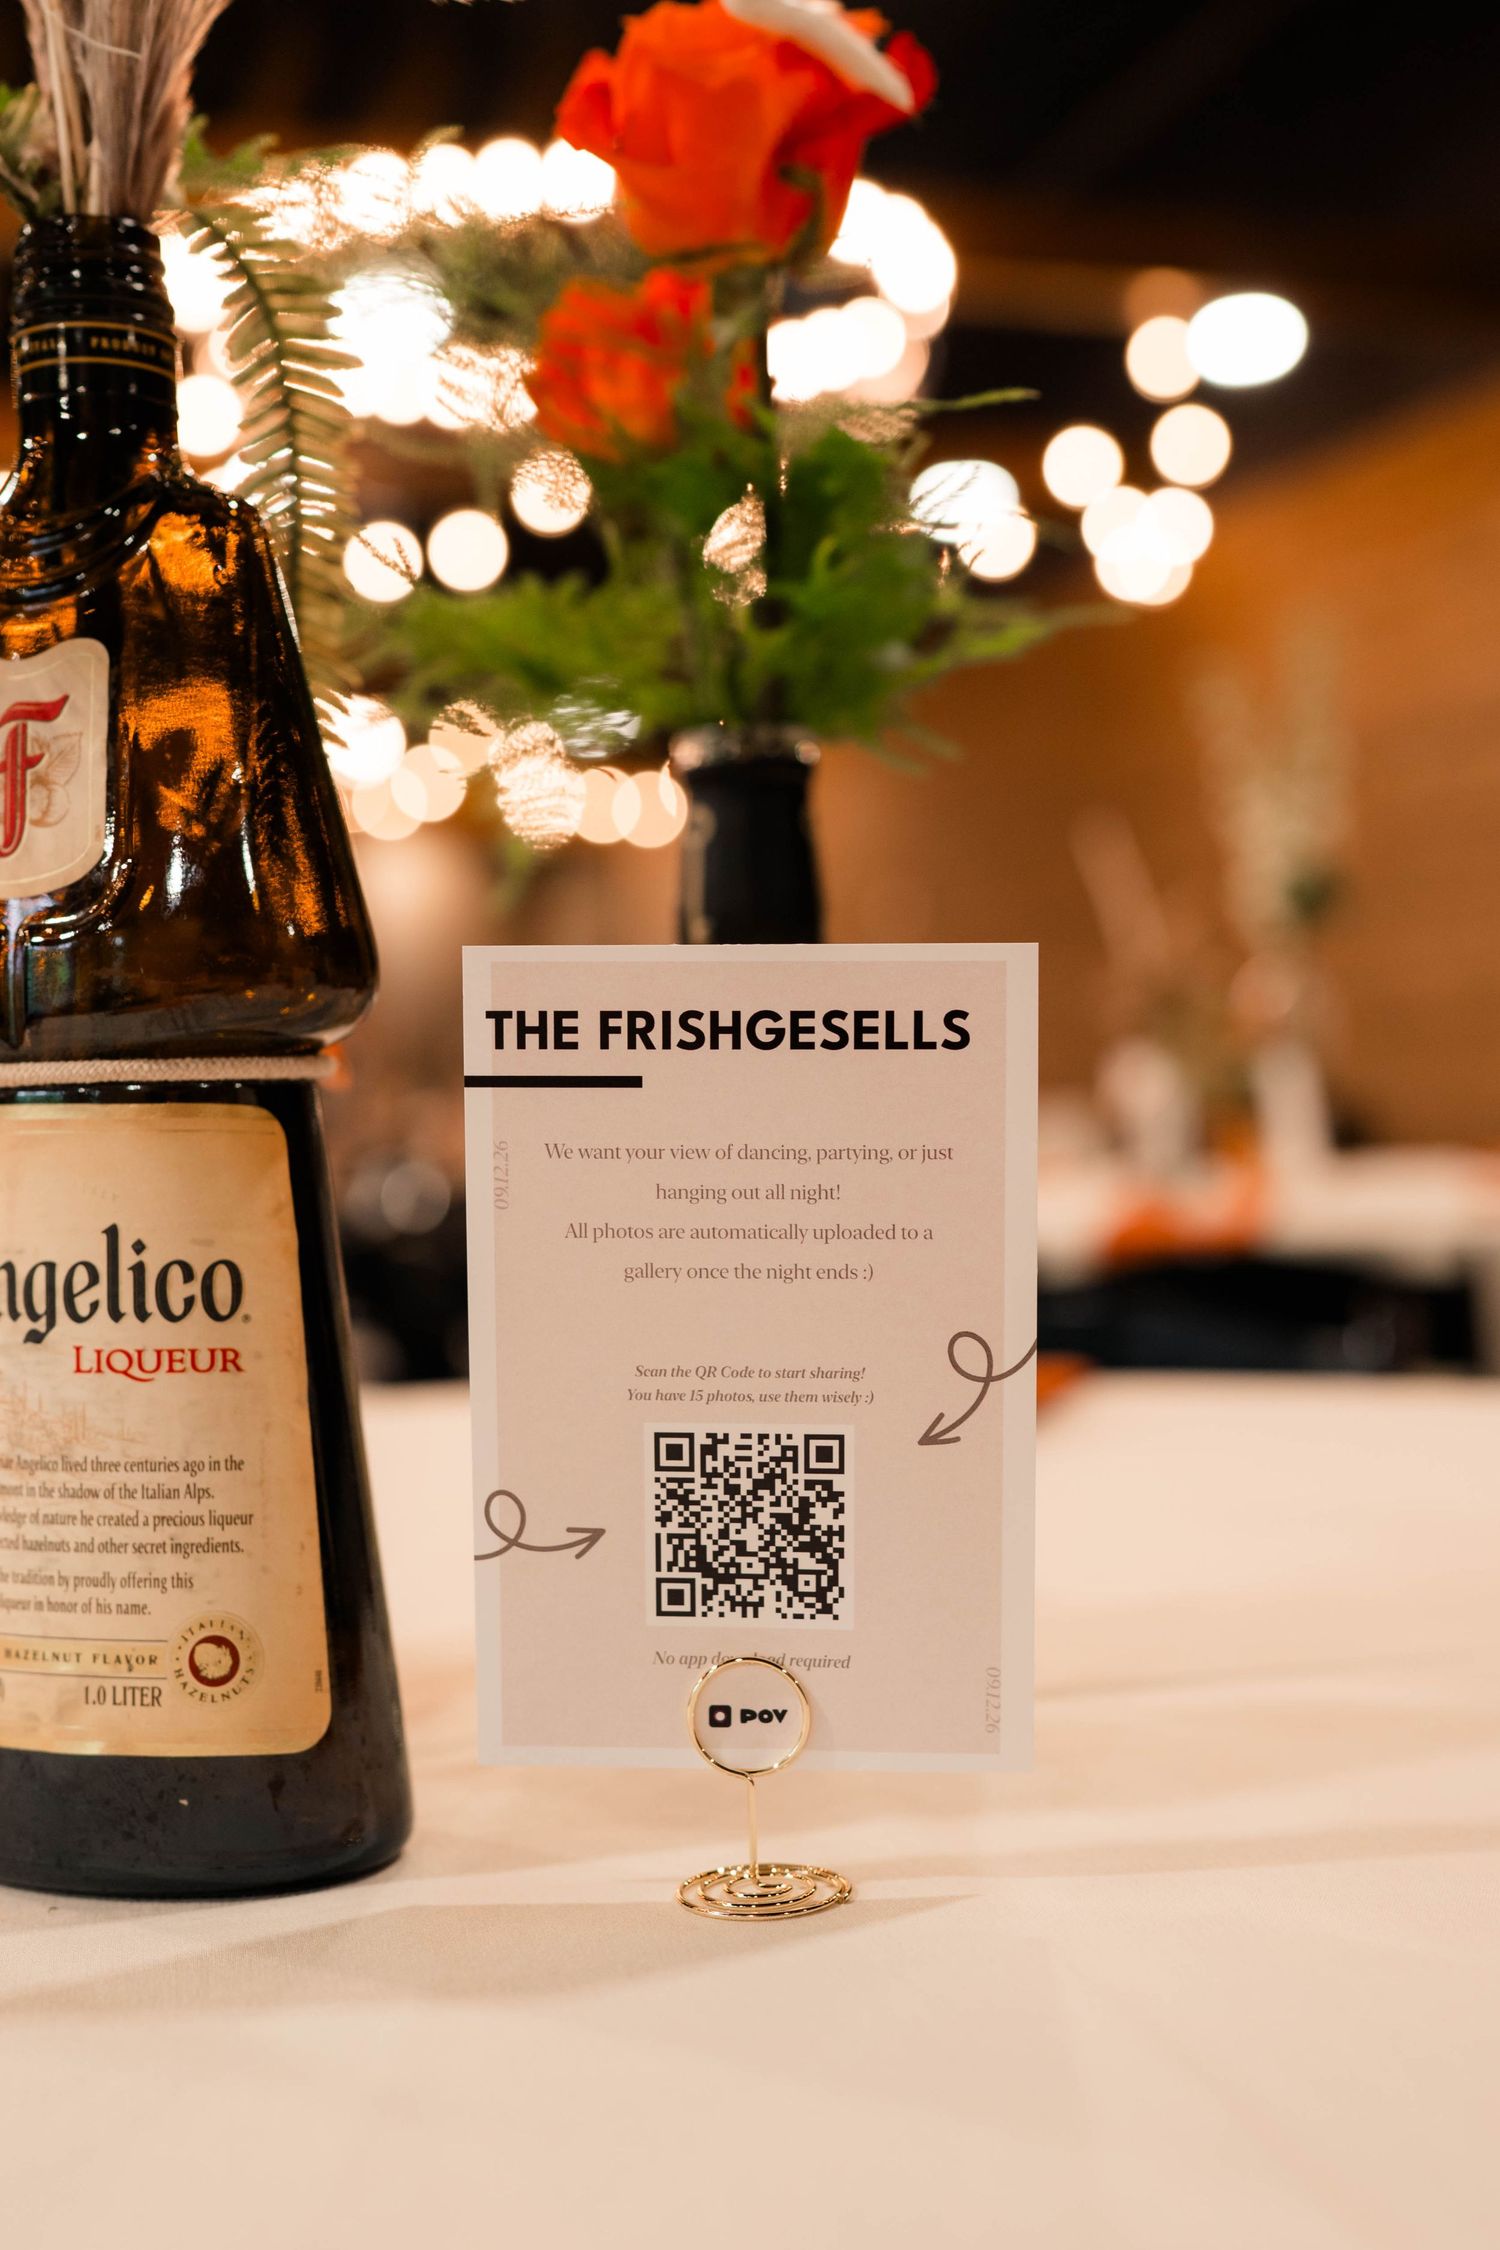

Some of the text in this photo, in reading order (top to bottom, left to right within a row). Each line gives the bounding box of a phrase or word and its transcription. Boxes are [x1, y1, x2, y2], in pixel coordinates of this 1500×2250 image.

[485, 1009, 971, 1051] THE FRISHGESELLS
[544, 1143, 954, 1165] We want your view of dancing, partying, or just
[493, 1140, 510, 1210] 09.12.26
[656, 1183, 841, 1205] hanging out all night!
[565, 1222, 934, 1245] All photos are automatically uploaded to a
[624, 1262, 874, 1284] gallery once the night ends :)
[73, 1346, 245, 1382] LIQUEUR
[635, 1364, 866, 1383] Scan the QR Code to start sharing!
[627, 1388, 875, 1407] You have 15 photos, use them wisely :)
[61, 1456, 88, 1472] lived
[91, 1456, 121, 1472] three
[123, 1456, 180, 1473] centuries
[183, 1460, 205, 1477] ago
[208, 1455, 220, 1471] in
[224, 1454, 245, 1471] the
[38, 1481, 55, 1498] the
[57, 1482, 100, 1499] shadow
[103, 1482, 116, 1499] of
[119, 1482, 138, 1499] the
[141, 1482, 180, 1499] Italian
[183, 1482, 215, 1504] Alps.
[29, 1508, 40, 1525] of
[42, 1512, 77, 1526] nature
[80, 1509, 94, 1526] he
[96, 1510, 140, 1527] created
[142, 1515, 149, 1527] a
[152, 1510, 205, 1532] precious
[208, 1510, 254, 1531] liqueur
[22, 1534, 71, 1553] hazelnuts
[73, 1536, 95, 1553] and
[97, 1537, 129, 1554] other
[131, 1541, 167, 1554] secret
[170, 1537, 244, 1559] ingredients.
[11, 1569, 55, 1586] tradition
[57, 1569, 70, 1592] by
[73, 1571, 117, 1594] proudly
[119, 1572, 168, 1594] offering
[171, 1572, 194, 1589] this
[46, 1595, 78, 1614] honor
[80, 1597, 92, 1614] of
[95, 1598, 113, 1614] his
[116, 1603, 152, 1616] name.
[4, 1648, 158, 1665] HAZELNUT FLAVOR
[652, 1650, 675, 1665] No
[679, 1655, 708, 1670] app
[789, 1652, 852, 1670] required
[84, 1685, 163, 1708] 1.0 LITER
[174, 1668, 255, 1703] HAZELNUTS
[984, 1667, 1001, 1734] 09.12.26
[739, 1708, 789, 1724] POV
